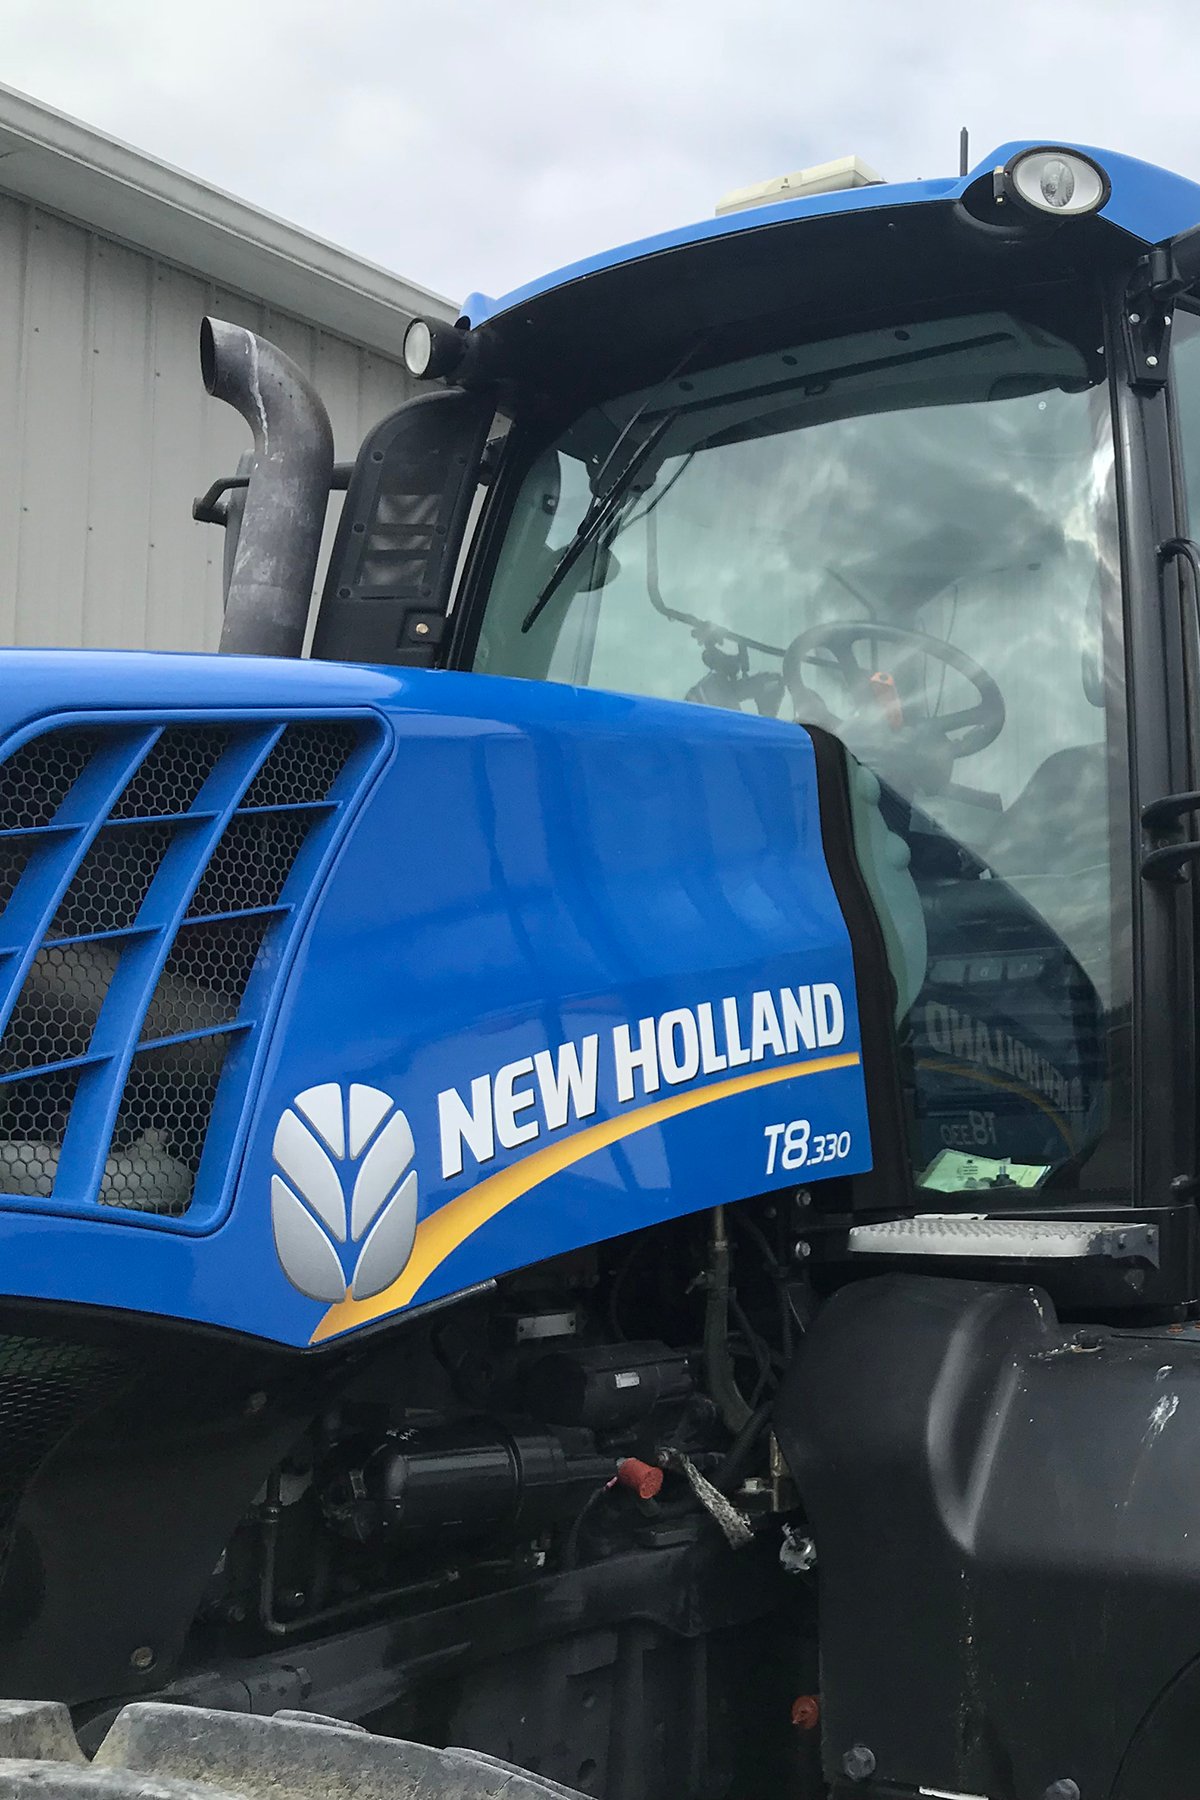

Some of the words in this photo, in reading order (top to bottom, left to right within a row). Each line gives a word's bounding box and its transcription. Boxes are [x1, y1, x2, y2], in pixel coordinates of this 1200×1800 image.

[438, 1034, 598, 1179] NEW
[613, 982, 845, 1102] HOLLAND
[764, 1119, 851, 1175] T8.330
